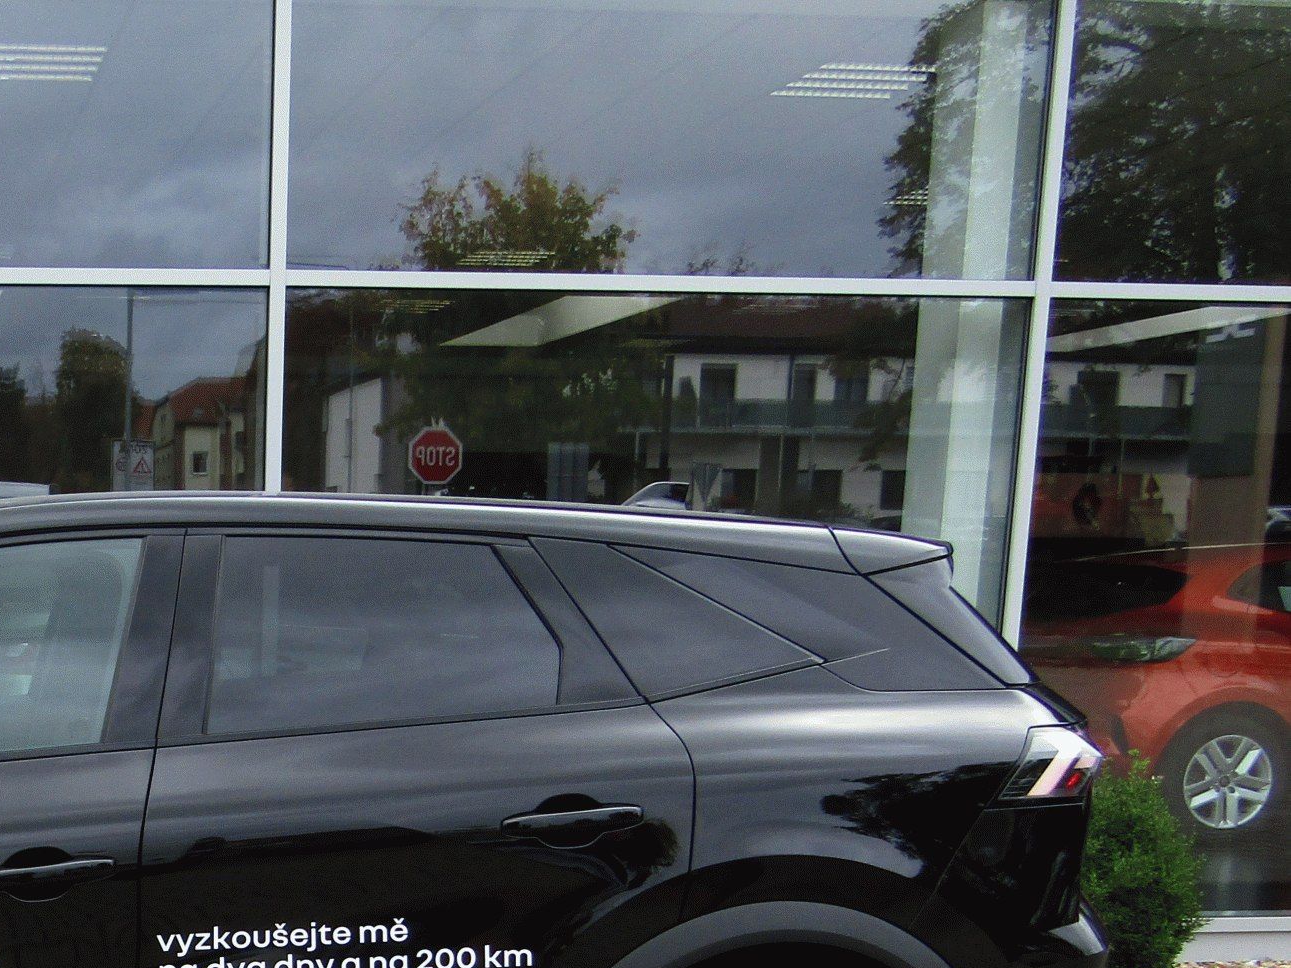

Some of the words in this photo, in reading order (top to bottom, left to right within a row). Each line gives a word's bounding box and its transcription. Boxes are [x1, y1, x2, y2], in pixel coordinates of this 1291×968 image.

[156, 921, 352, 958] vyzkoušejte
[358, 917, 409, 944] mě
[484, 944, 533, 968] km
